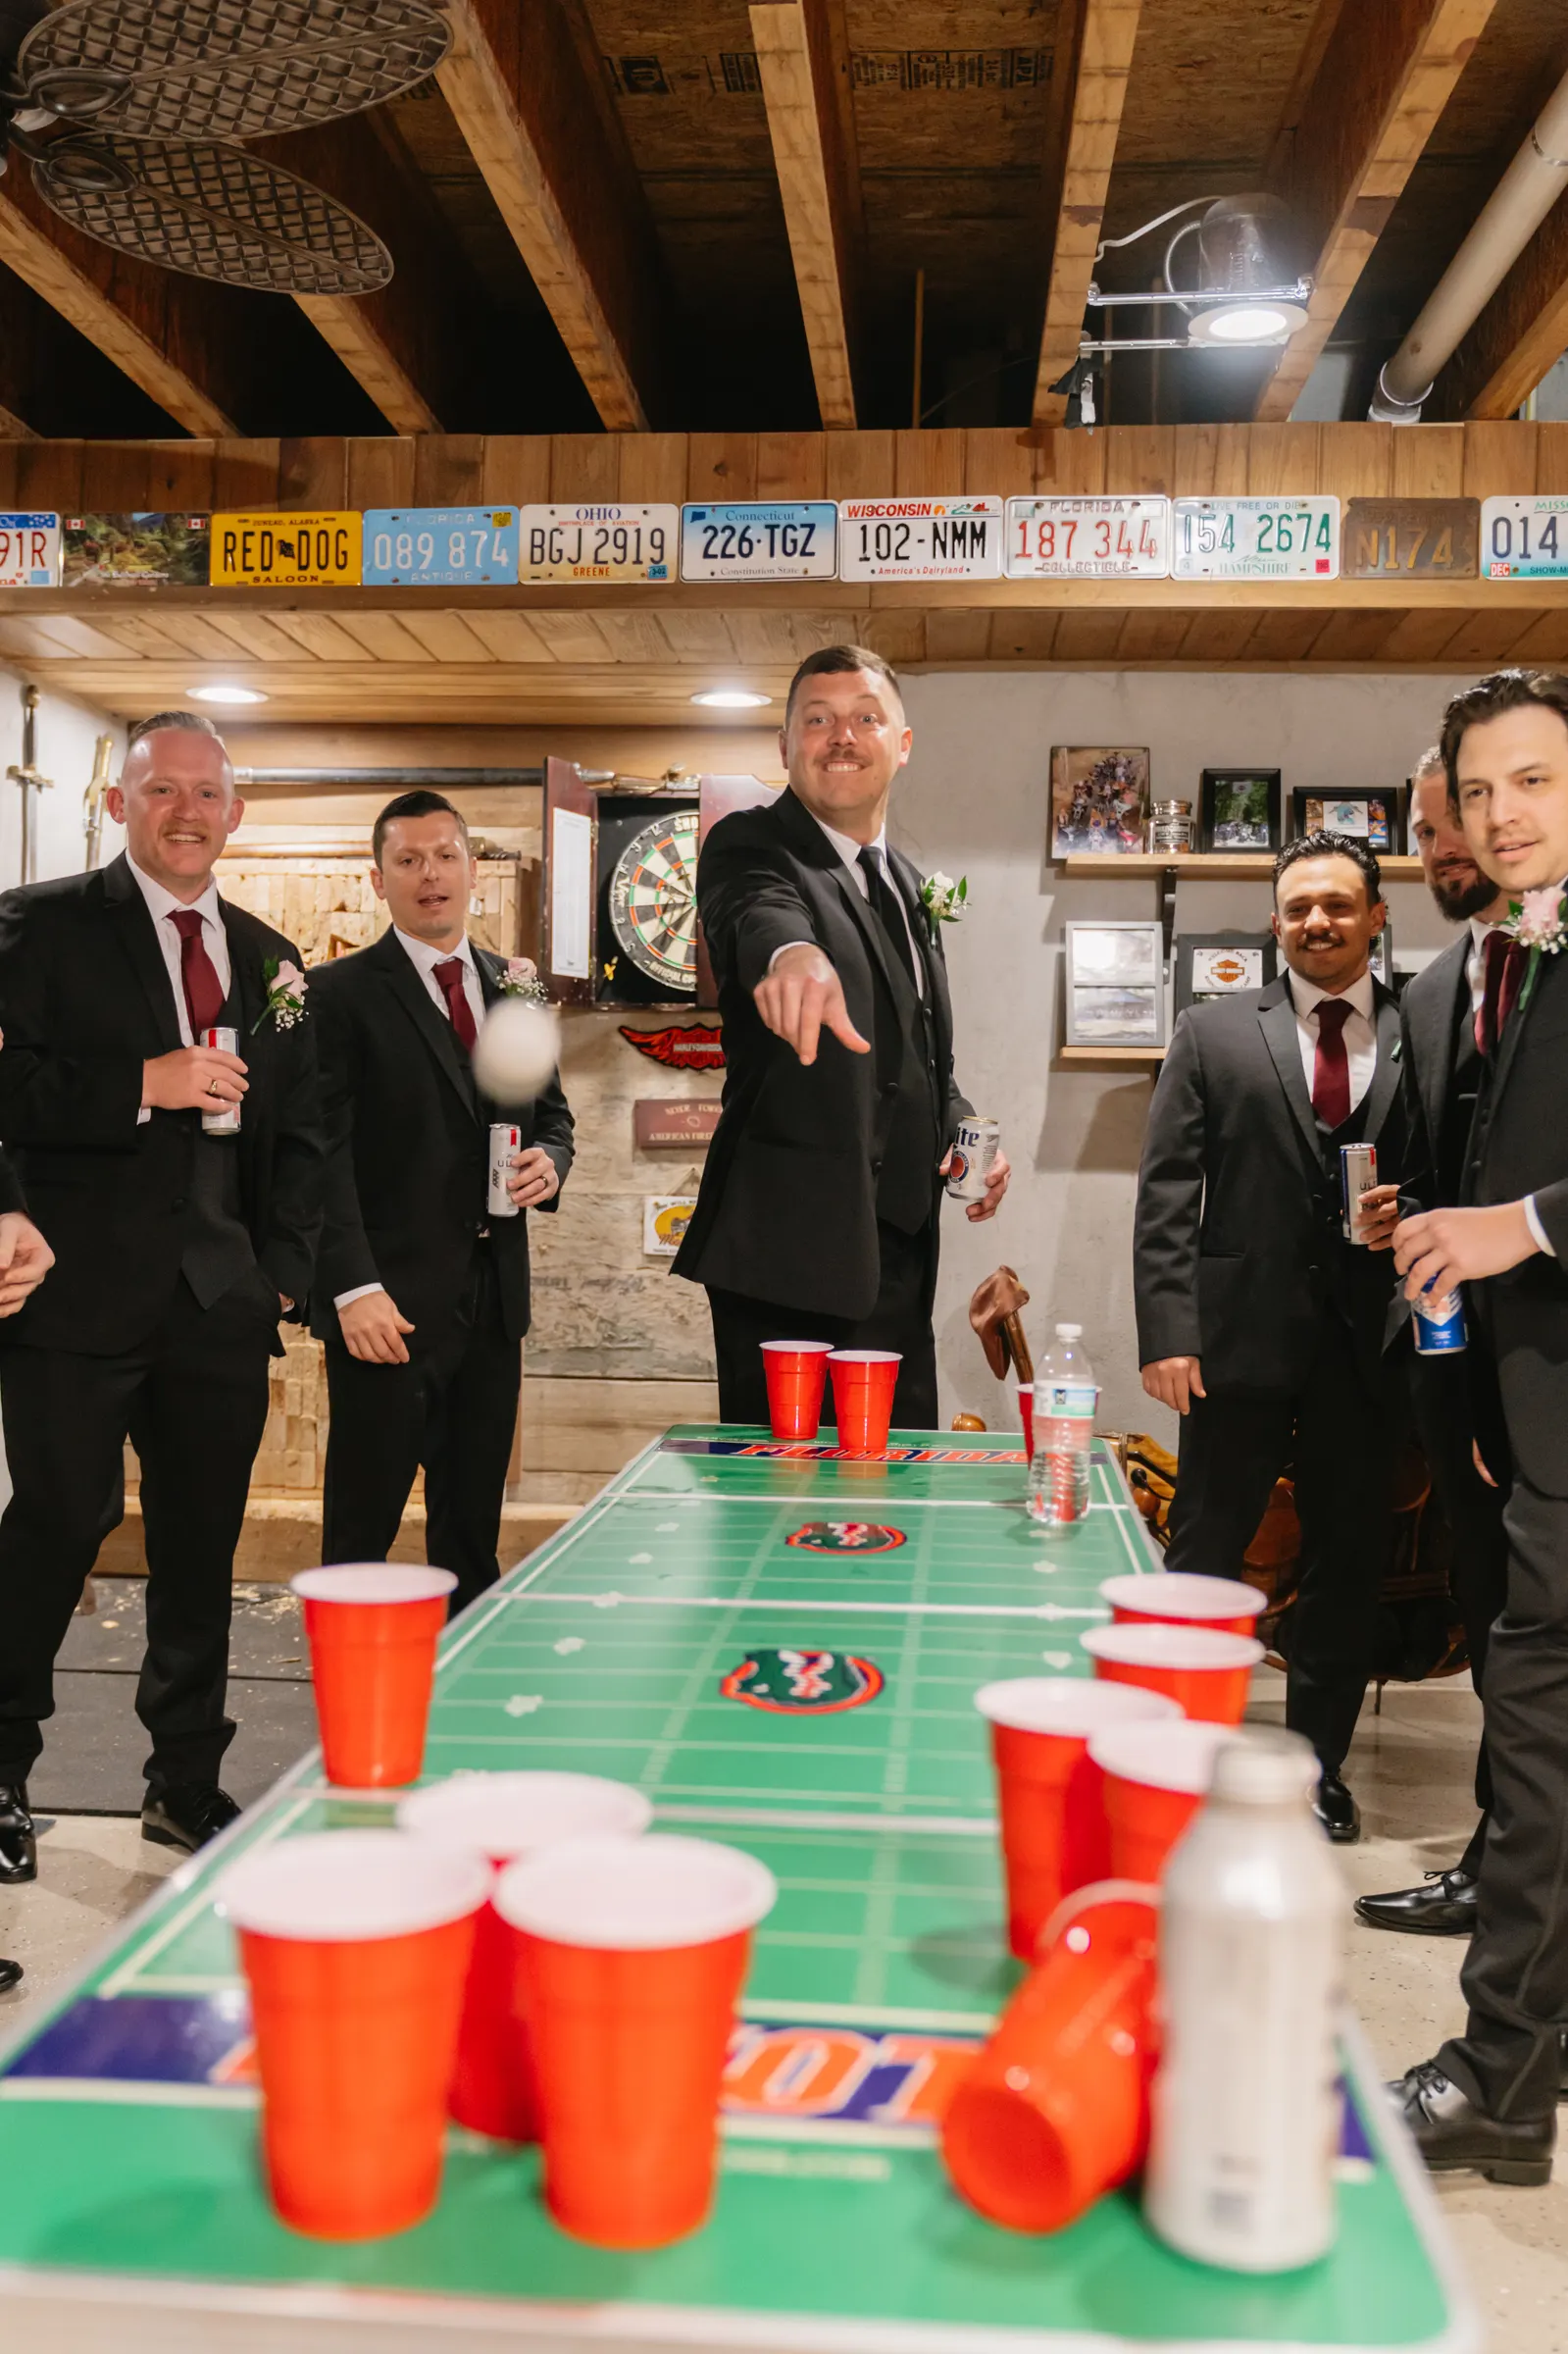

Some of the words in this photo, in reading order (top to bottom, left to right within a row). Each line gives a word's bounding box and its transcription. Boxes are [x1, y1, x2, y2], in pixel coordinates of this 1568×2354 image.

[847, 503, 932, 518] WISCONSIN
[1049, 501, 1124, 513] FLORIDA
[576, 508, 621, 520] OHIO
[726, 510, 794, 521] Connecticut
[1185, 514, 1235, 553] 154
[1256, 513, 1331, 553] 2674
[1015, 520, 1079, 559] 187
[1094, 520, 1157, 559] 344
[224, 531, 273, 572] RED
[298, 530, 348, 571] DOG
[375, 533, 433, 570] 089
[448, 531, 509, 568] 874
[531, 528, 582, 565] BGJ
[594, 528, 665, 565] 2919
[1356, 526, 1453, 570] N174
[573, 567, 610, 576] GREENE
[721, 566, 776, 576] Constitution
[923, 566, 964, 575] Dairyland
[1041, 561, 1132, 573] COLLECTIBLE
[1219, 563, 1290, 574] HAMPSHIRE
[1491, 564, 1509, 576] DEC
[253, 575, 320, 584] SALOON
[411, 571, 473, 582] ANTIQUE
[649, 1132, 690, 1142] AMERICAN
[731, 1444, 1030, 1462] FLORIDA
